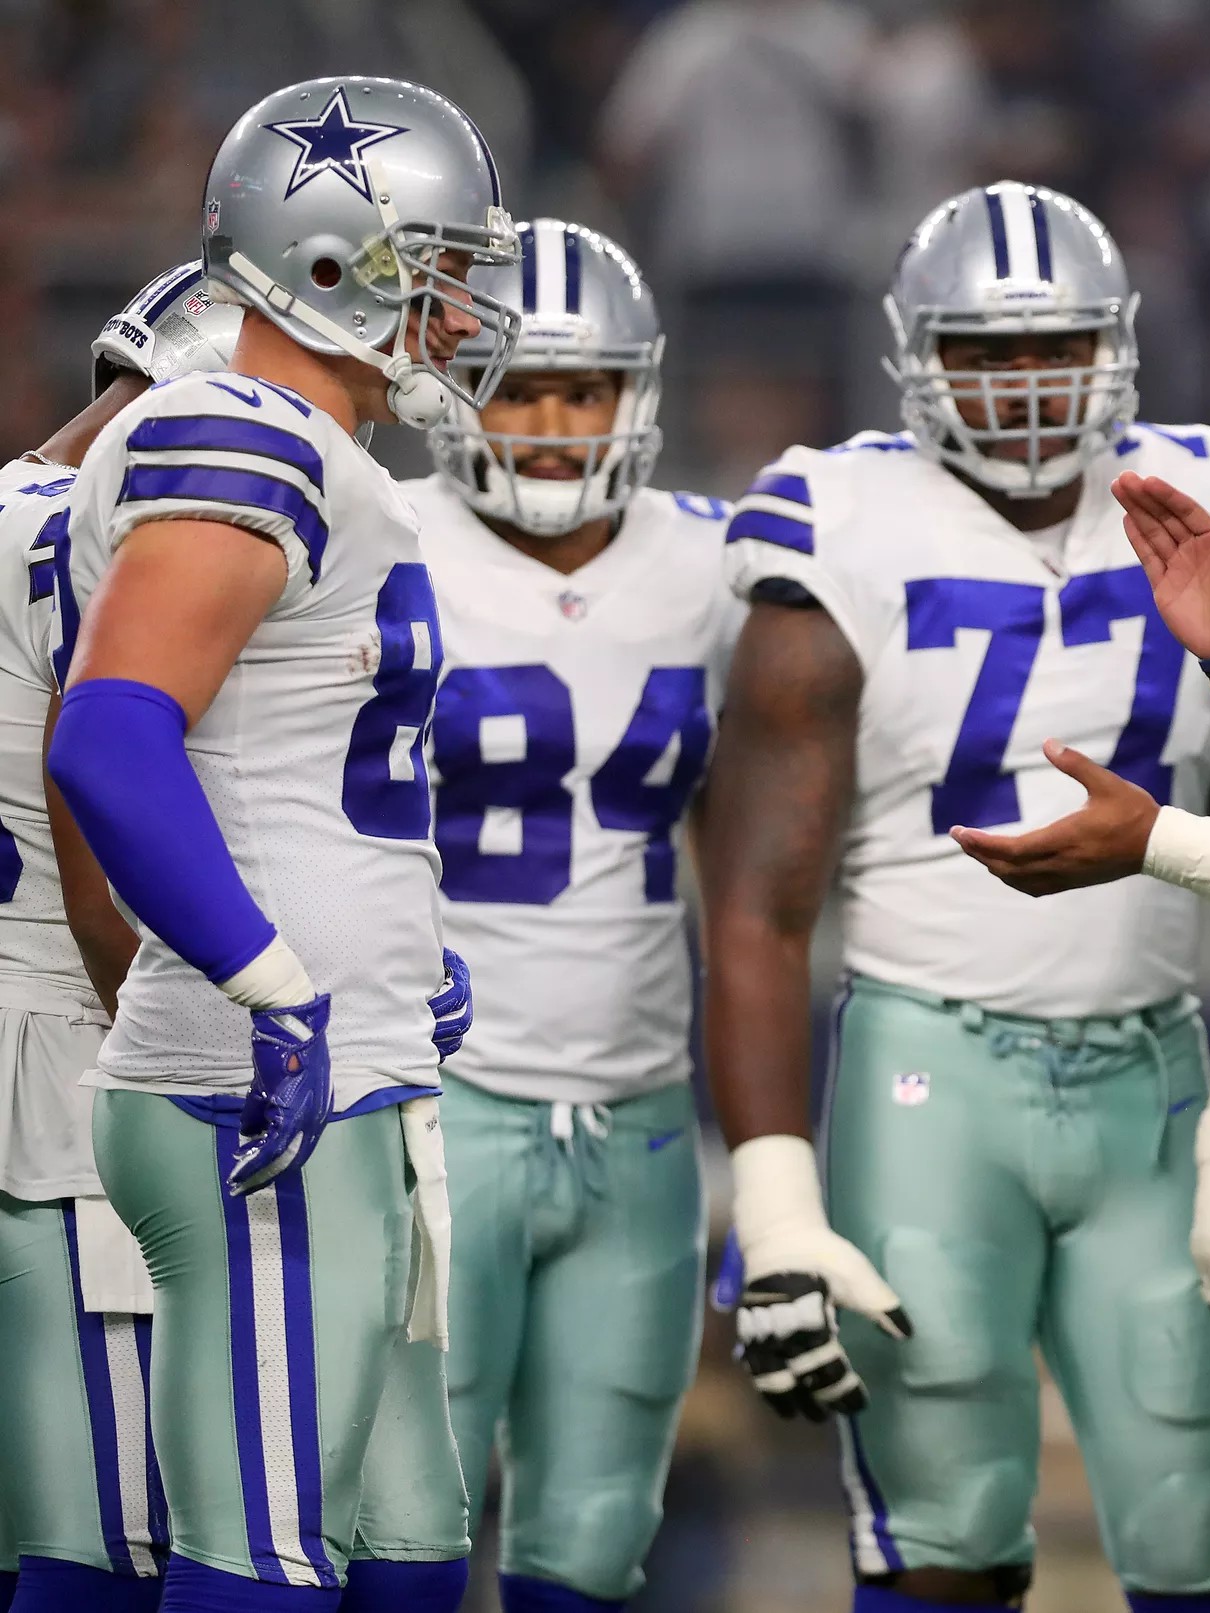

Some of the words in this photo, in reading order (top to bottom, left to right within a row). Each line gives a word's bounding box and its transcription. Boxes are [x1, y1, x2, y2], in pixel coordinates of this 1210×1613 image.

[187, 297, 204, 314] NFL
[432, 662, 713, 905] 84
[904, 563, 1187, 836] 77
